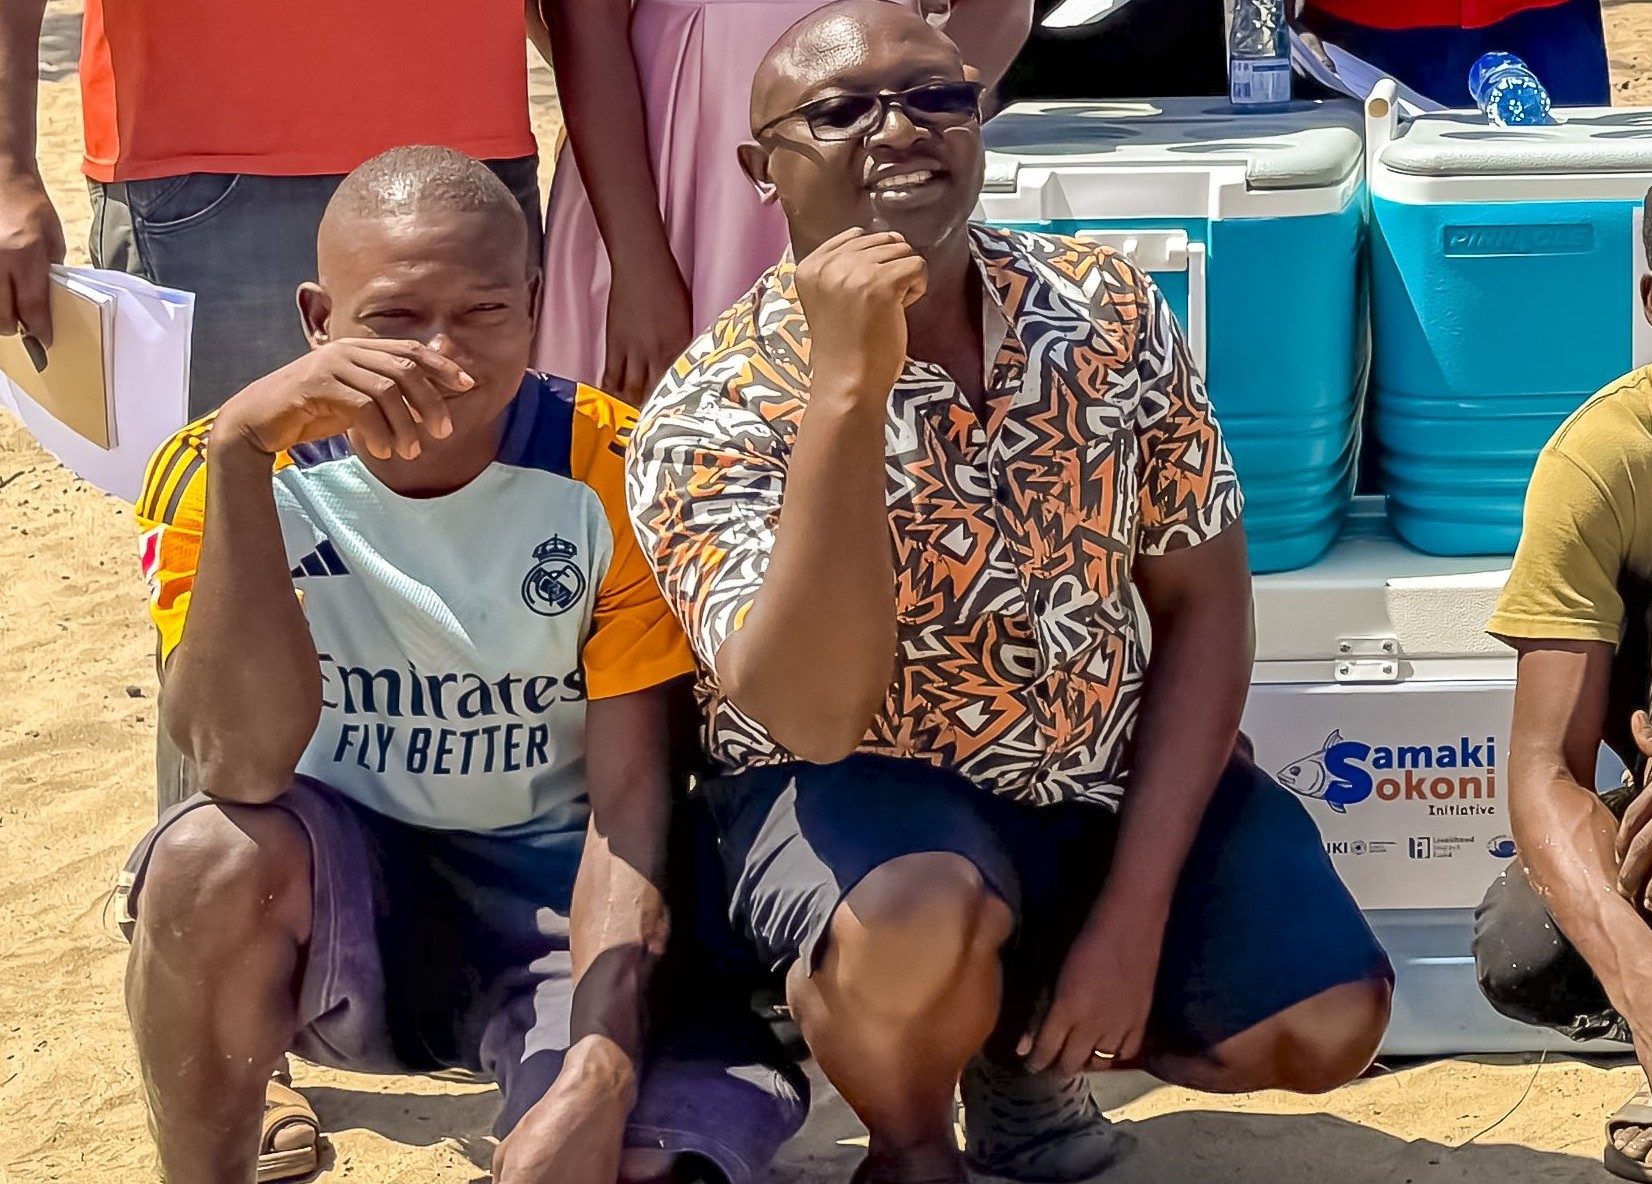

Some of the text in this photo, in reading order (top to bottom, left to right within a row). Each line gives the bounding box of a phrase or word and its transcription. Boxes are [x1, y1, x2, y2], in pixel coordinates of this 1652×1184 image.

[334, 724, 549, 774] FLY BETTER
[1428, 805, 1495, 816] Initiative
